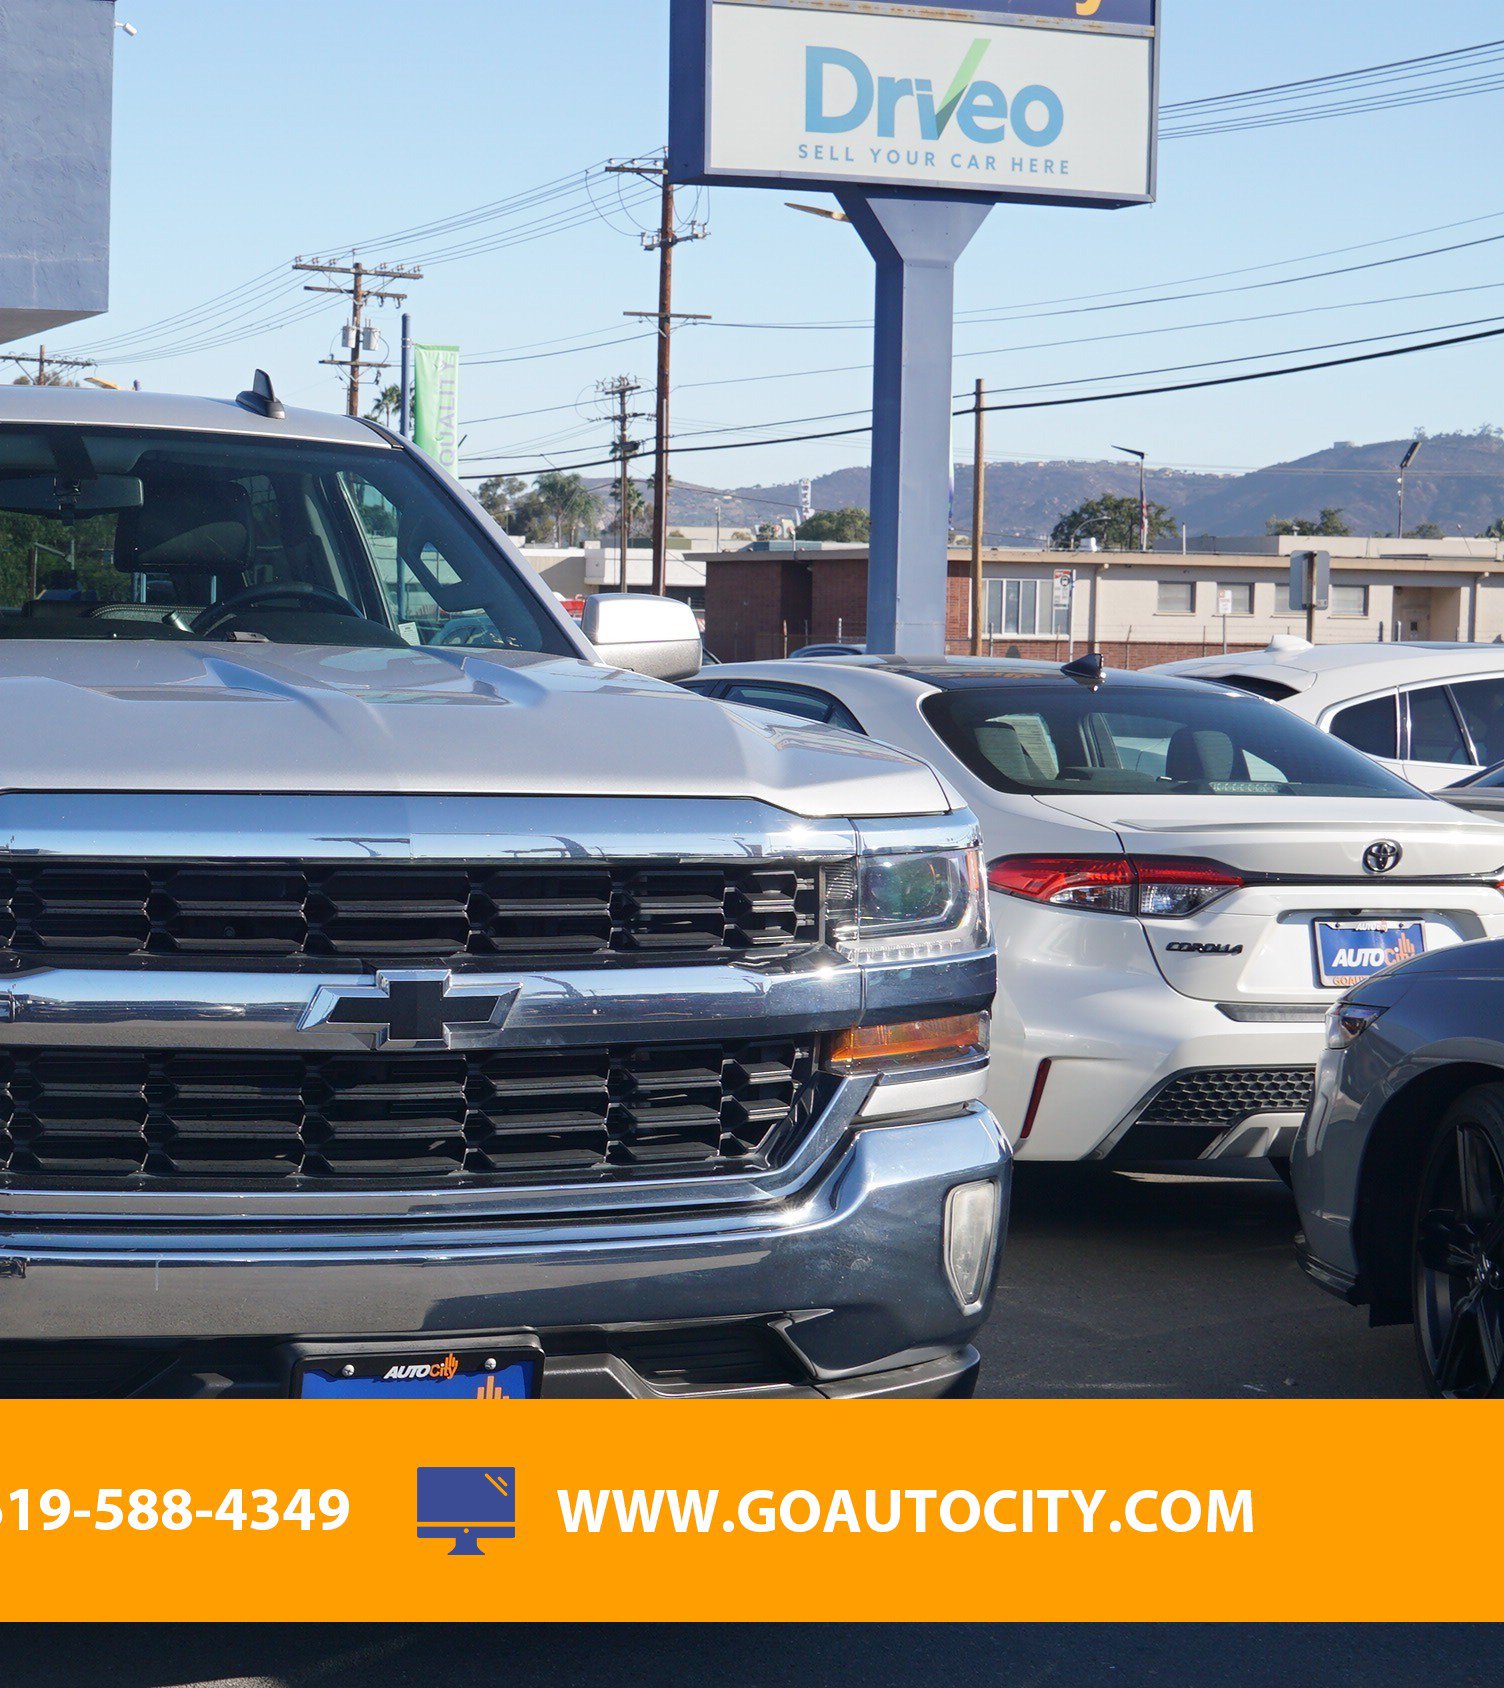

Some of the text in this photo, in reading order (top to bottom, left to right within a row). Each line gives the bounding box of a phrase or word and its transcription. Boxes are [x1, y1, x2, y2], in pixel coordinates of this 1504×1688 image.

[804, 39, 1064, 147] Driveo
[798, 143, 1069, 175] SELL YOUR CAR HERE
[439, 359, 456, 467] QUALITY
[1165, 941, 1244, 954] COROLLA
[1331, 938, 1416, 967] AUTOCit
